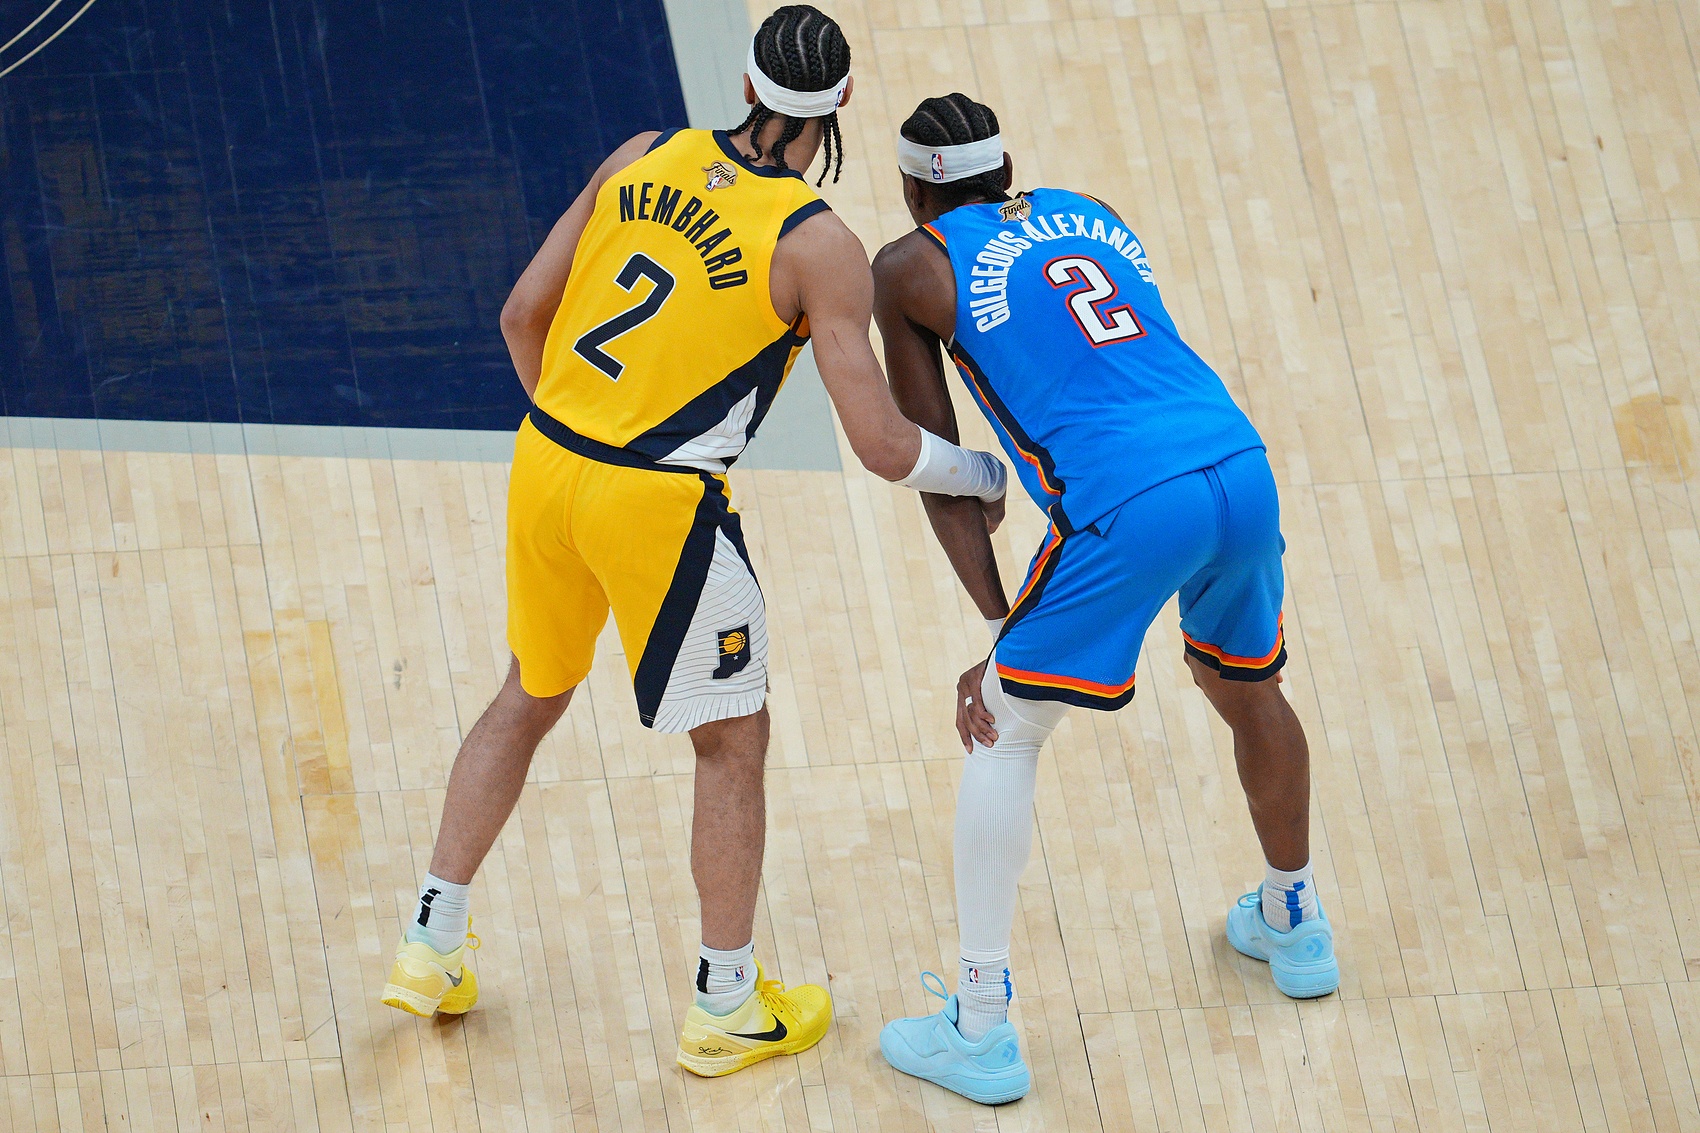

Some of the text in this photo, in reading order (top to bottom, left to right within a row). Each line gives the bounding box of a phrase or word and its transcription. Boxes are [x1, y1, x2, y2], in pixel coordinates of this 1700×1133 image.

[703, 161, 736, 185] Finals
[999, 199, 1031, 222] Finals
[619, 182, 748, 290] NEMBHARD
[571, 251, 677, 383] 2
[1042, 254, 1148, 349] 2
